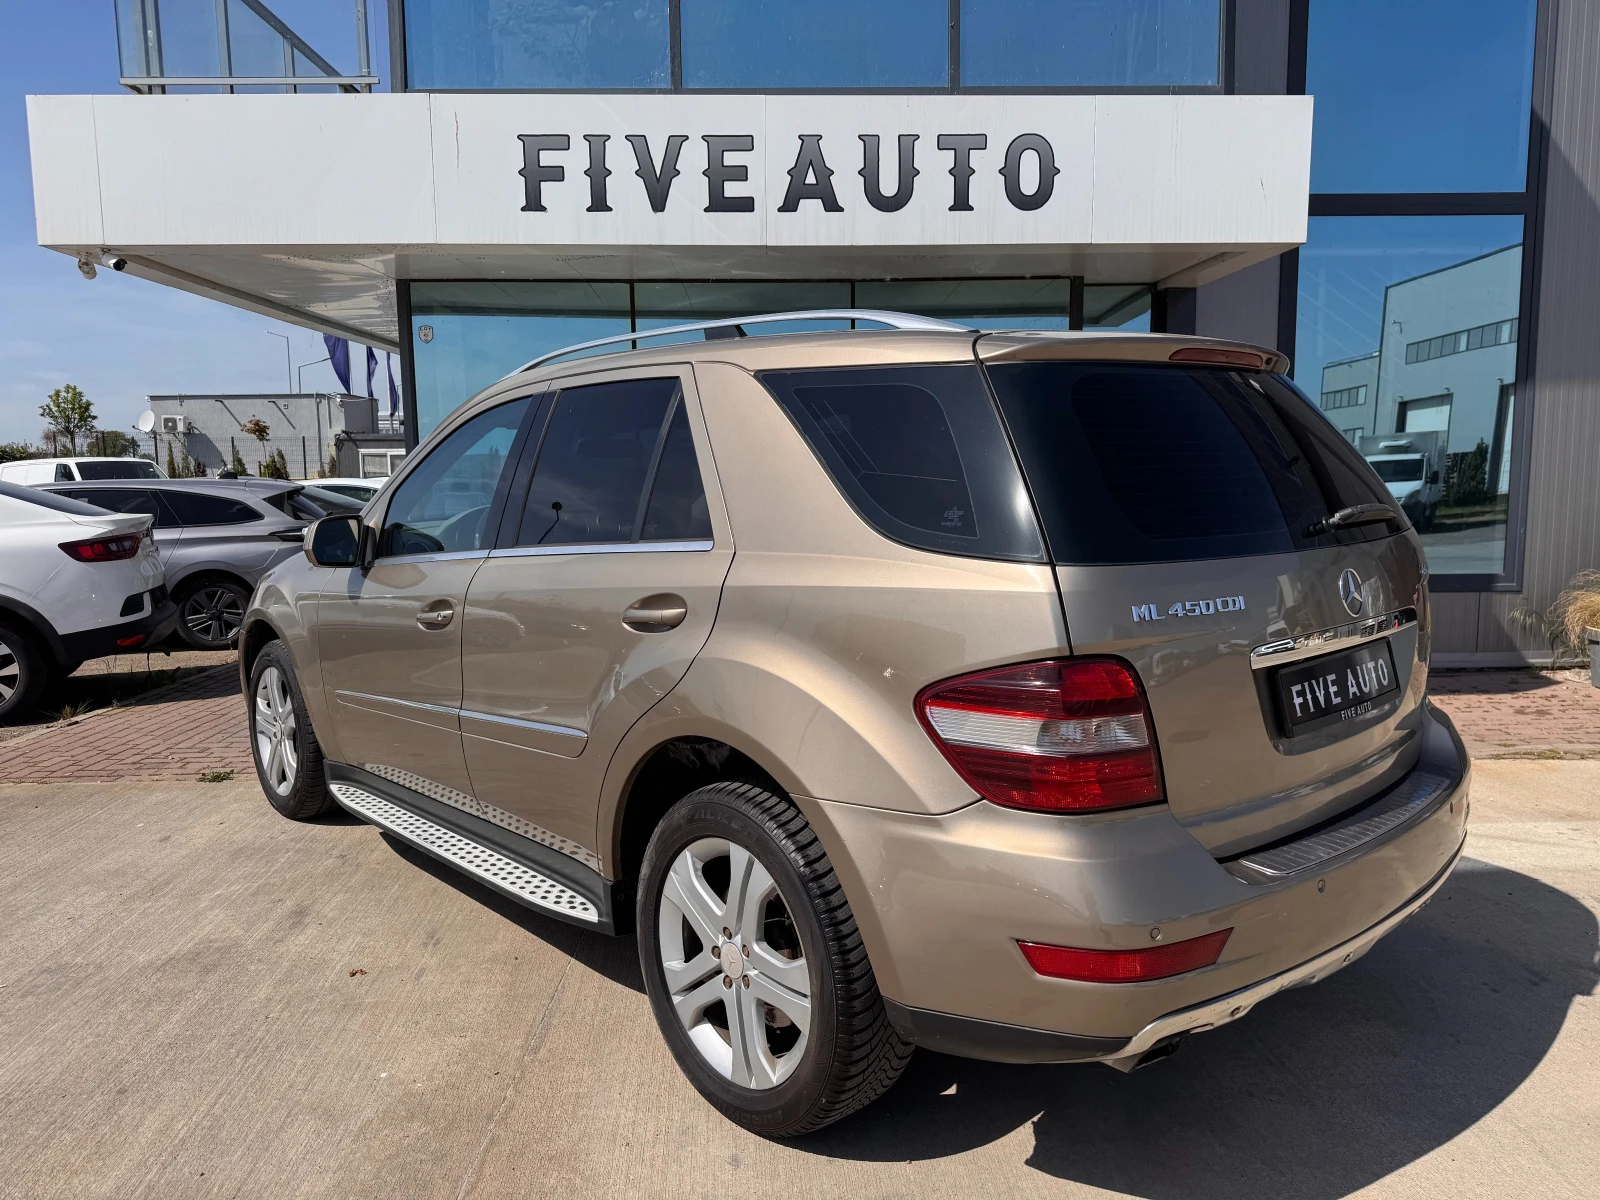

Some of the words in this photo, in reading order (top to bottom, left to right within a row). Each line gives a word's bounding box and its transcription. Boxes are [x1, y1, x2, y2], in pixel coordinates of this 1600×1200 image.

[1131, 603, 1166, 622] ML
[1168, 600, 1215, 617] 450
[1216, 595, 1246, 612] CDI
[1290, 673, 1342, 717] FIVE
[1346, 658, 1389, 699] AUTO
[1340, 707, 1356, 721] FIVE
[1357, 701, 1372, 717] AUTO
